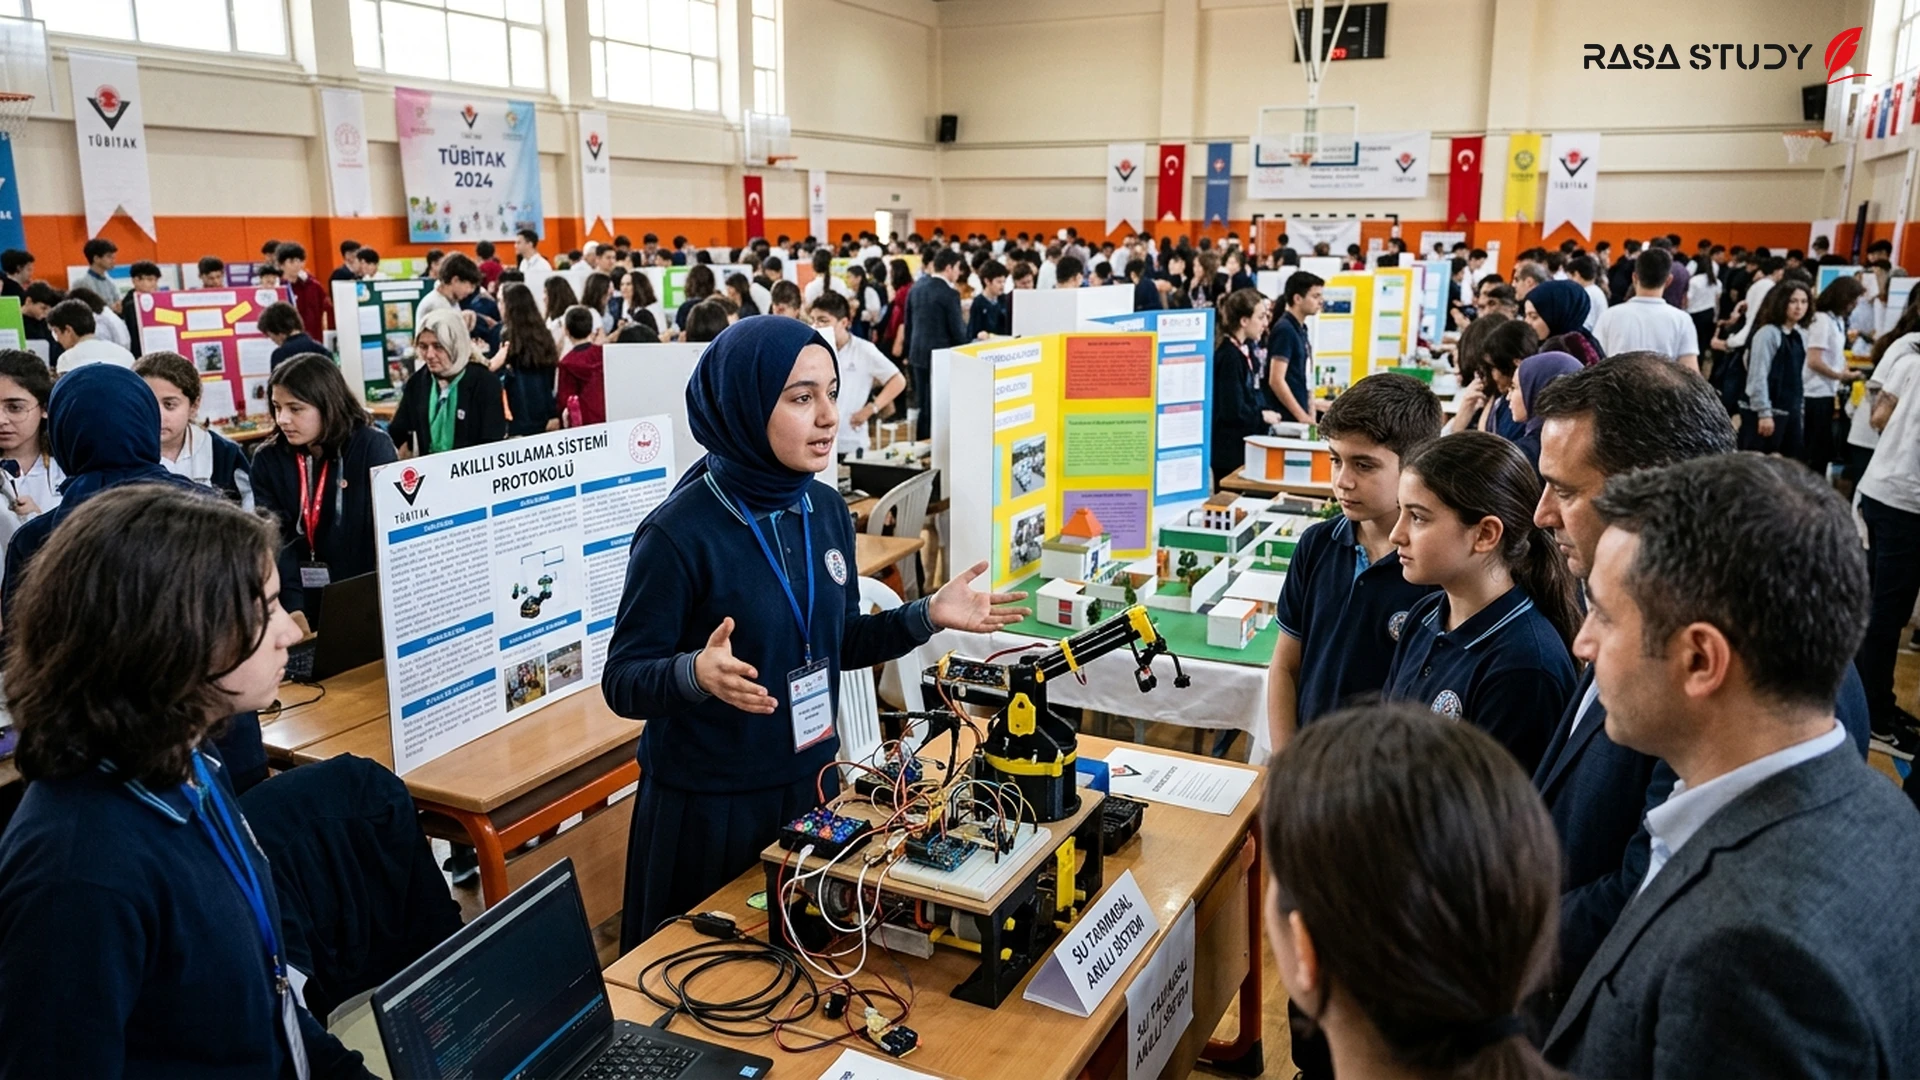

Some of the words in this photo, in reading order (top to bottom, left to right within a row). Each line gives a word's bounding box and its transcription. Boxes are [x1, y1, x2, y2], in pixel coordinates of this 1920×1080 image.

[438, 144, 506, 168] TÜBİTAK
[454, 171, 494, 188] 2024
[450, 456, 494, 479] AKILLI
[558, 430, 608, 456] SİSTEMİ
[492, 460, 574, 494] PROTOKOLÜ
[1071, 941, 1089, 965] SU
